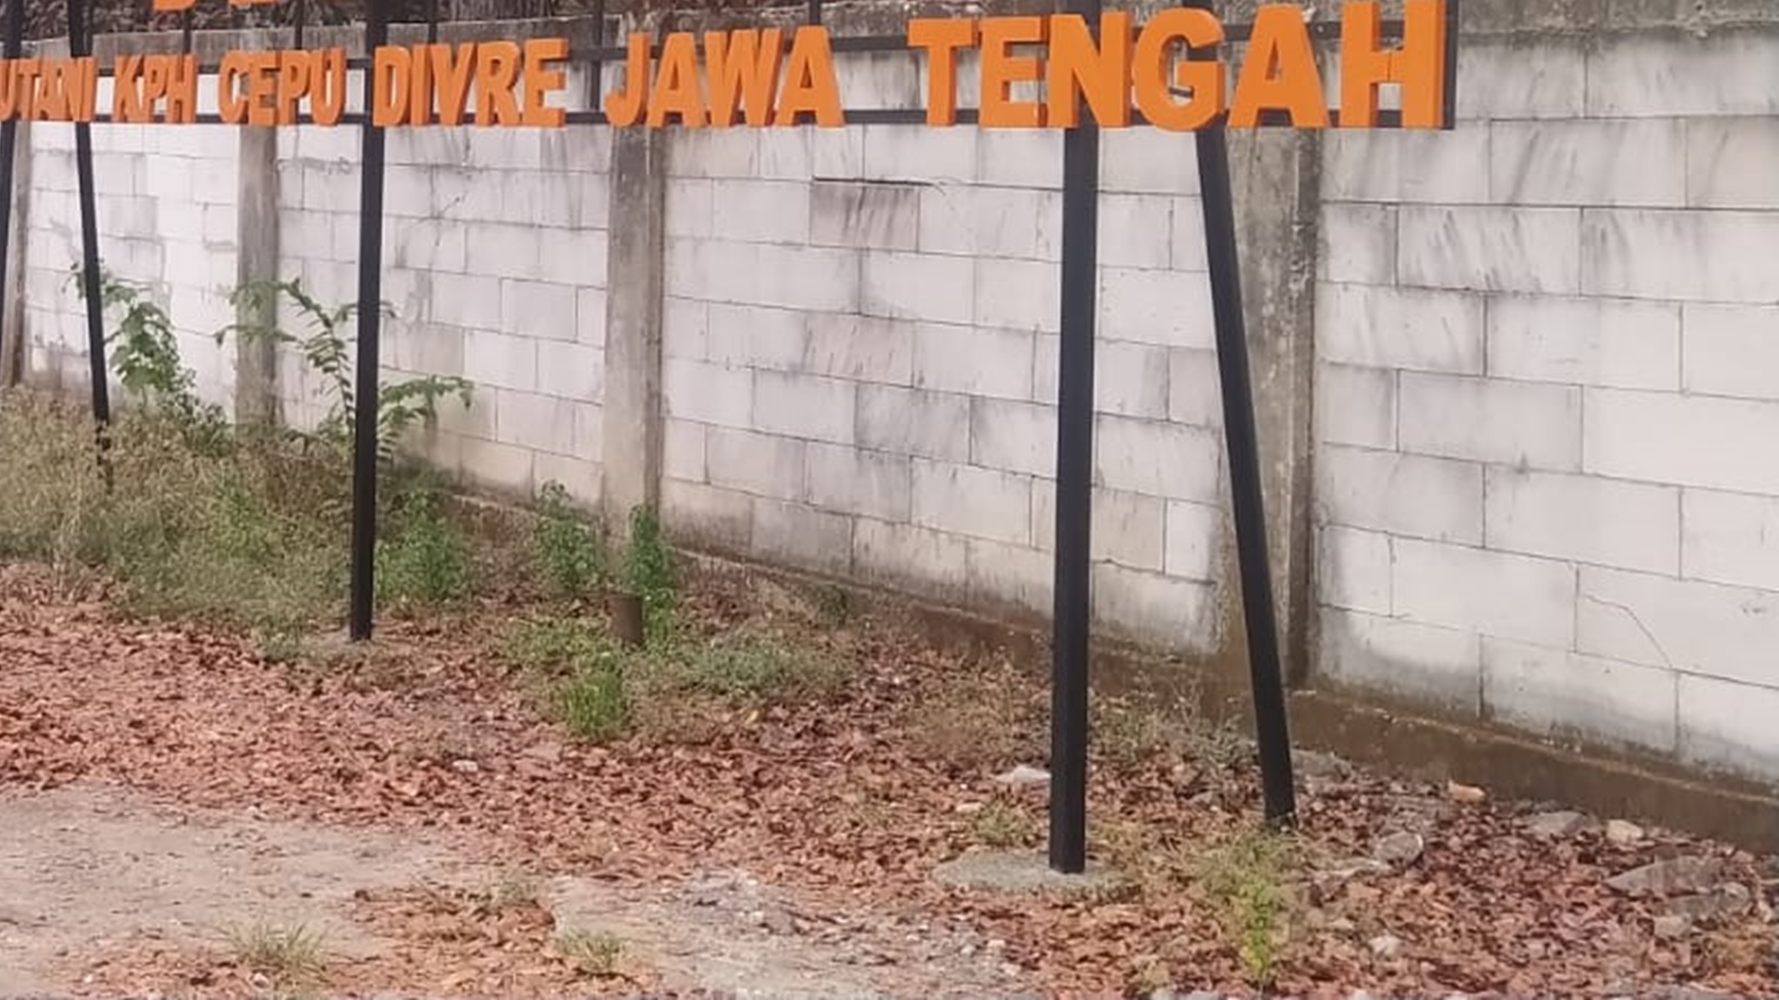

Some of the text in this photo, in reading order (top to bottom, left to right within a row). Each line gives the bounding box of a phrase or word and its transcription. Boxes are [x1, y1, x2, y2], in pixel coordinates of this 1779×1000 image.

[111, 53, 200, 124] KPH
[219, 47, 347, 128] CEPU
[372, 37, 570, 128] DIVRE
[604, 24, 845, 130] JAWA
